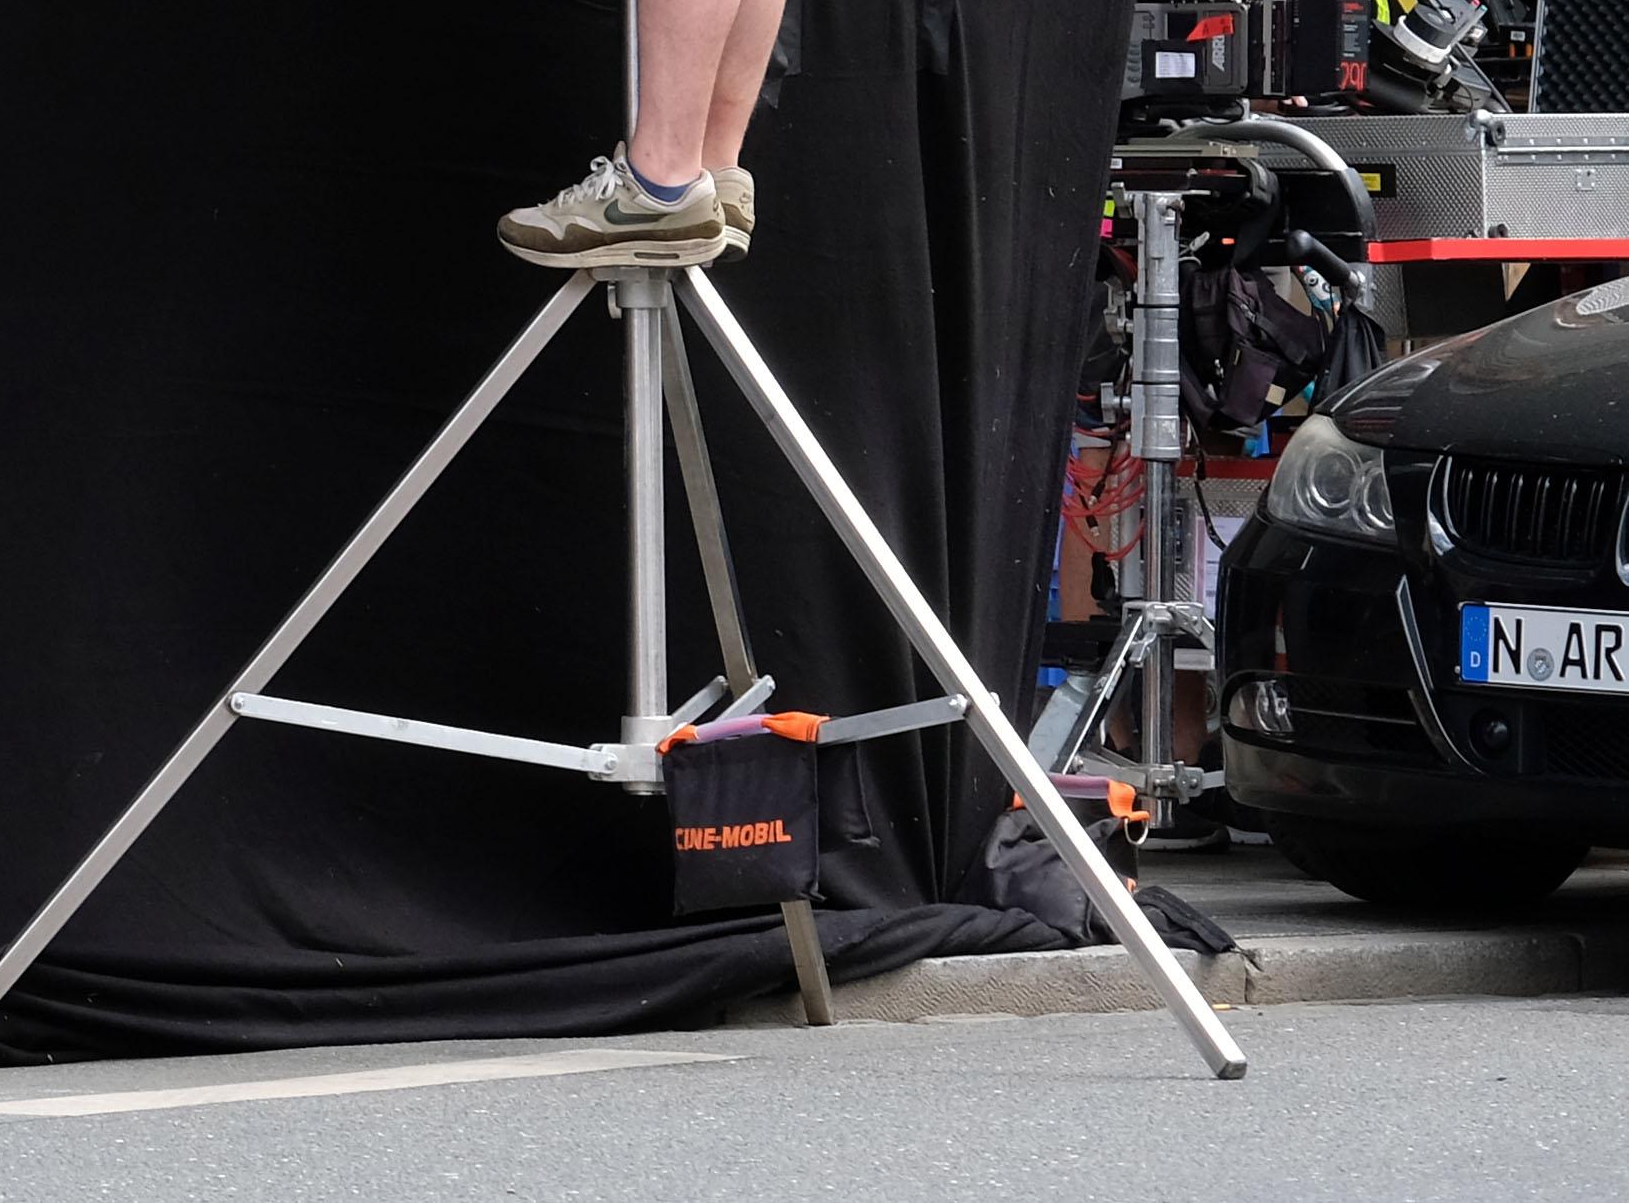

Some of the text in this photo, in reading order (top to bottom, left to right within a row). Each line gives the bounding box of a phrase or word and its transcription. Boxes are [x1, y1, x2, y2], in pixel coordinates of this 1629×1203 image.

[1470, 651, 1482, 668] D
[1492, 616, 1625, 682] N AR
[674, 819, 793, 851] CINE-MOBIL
